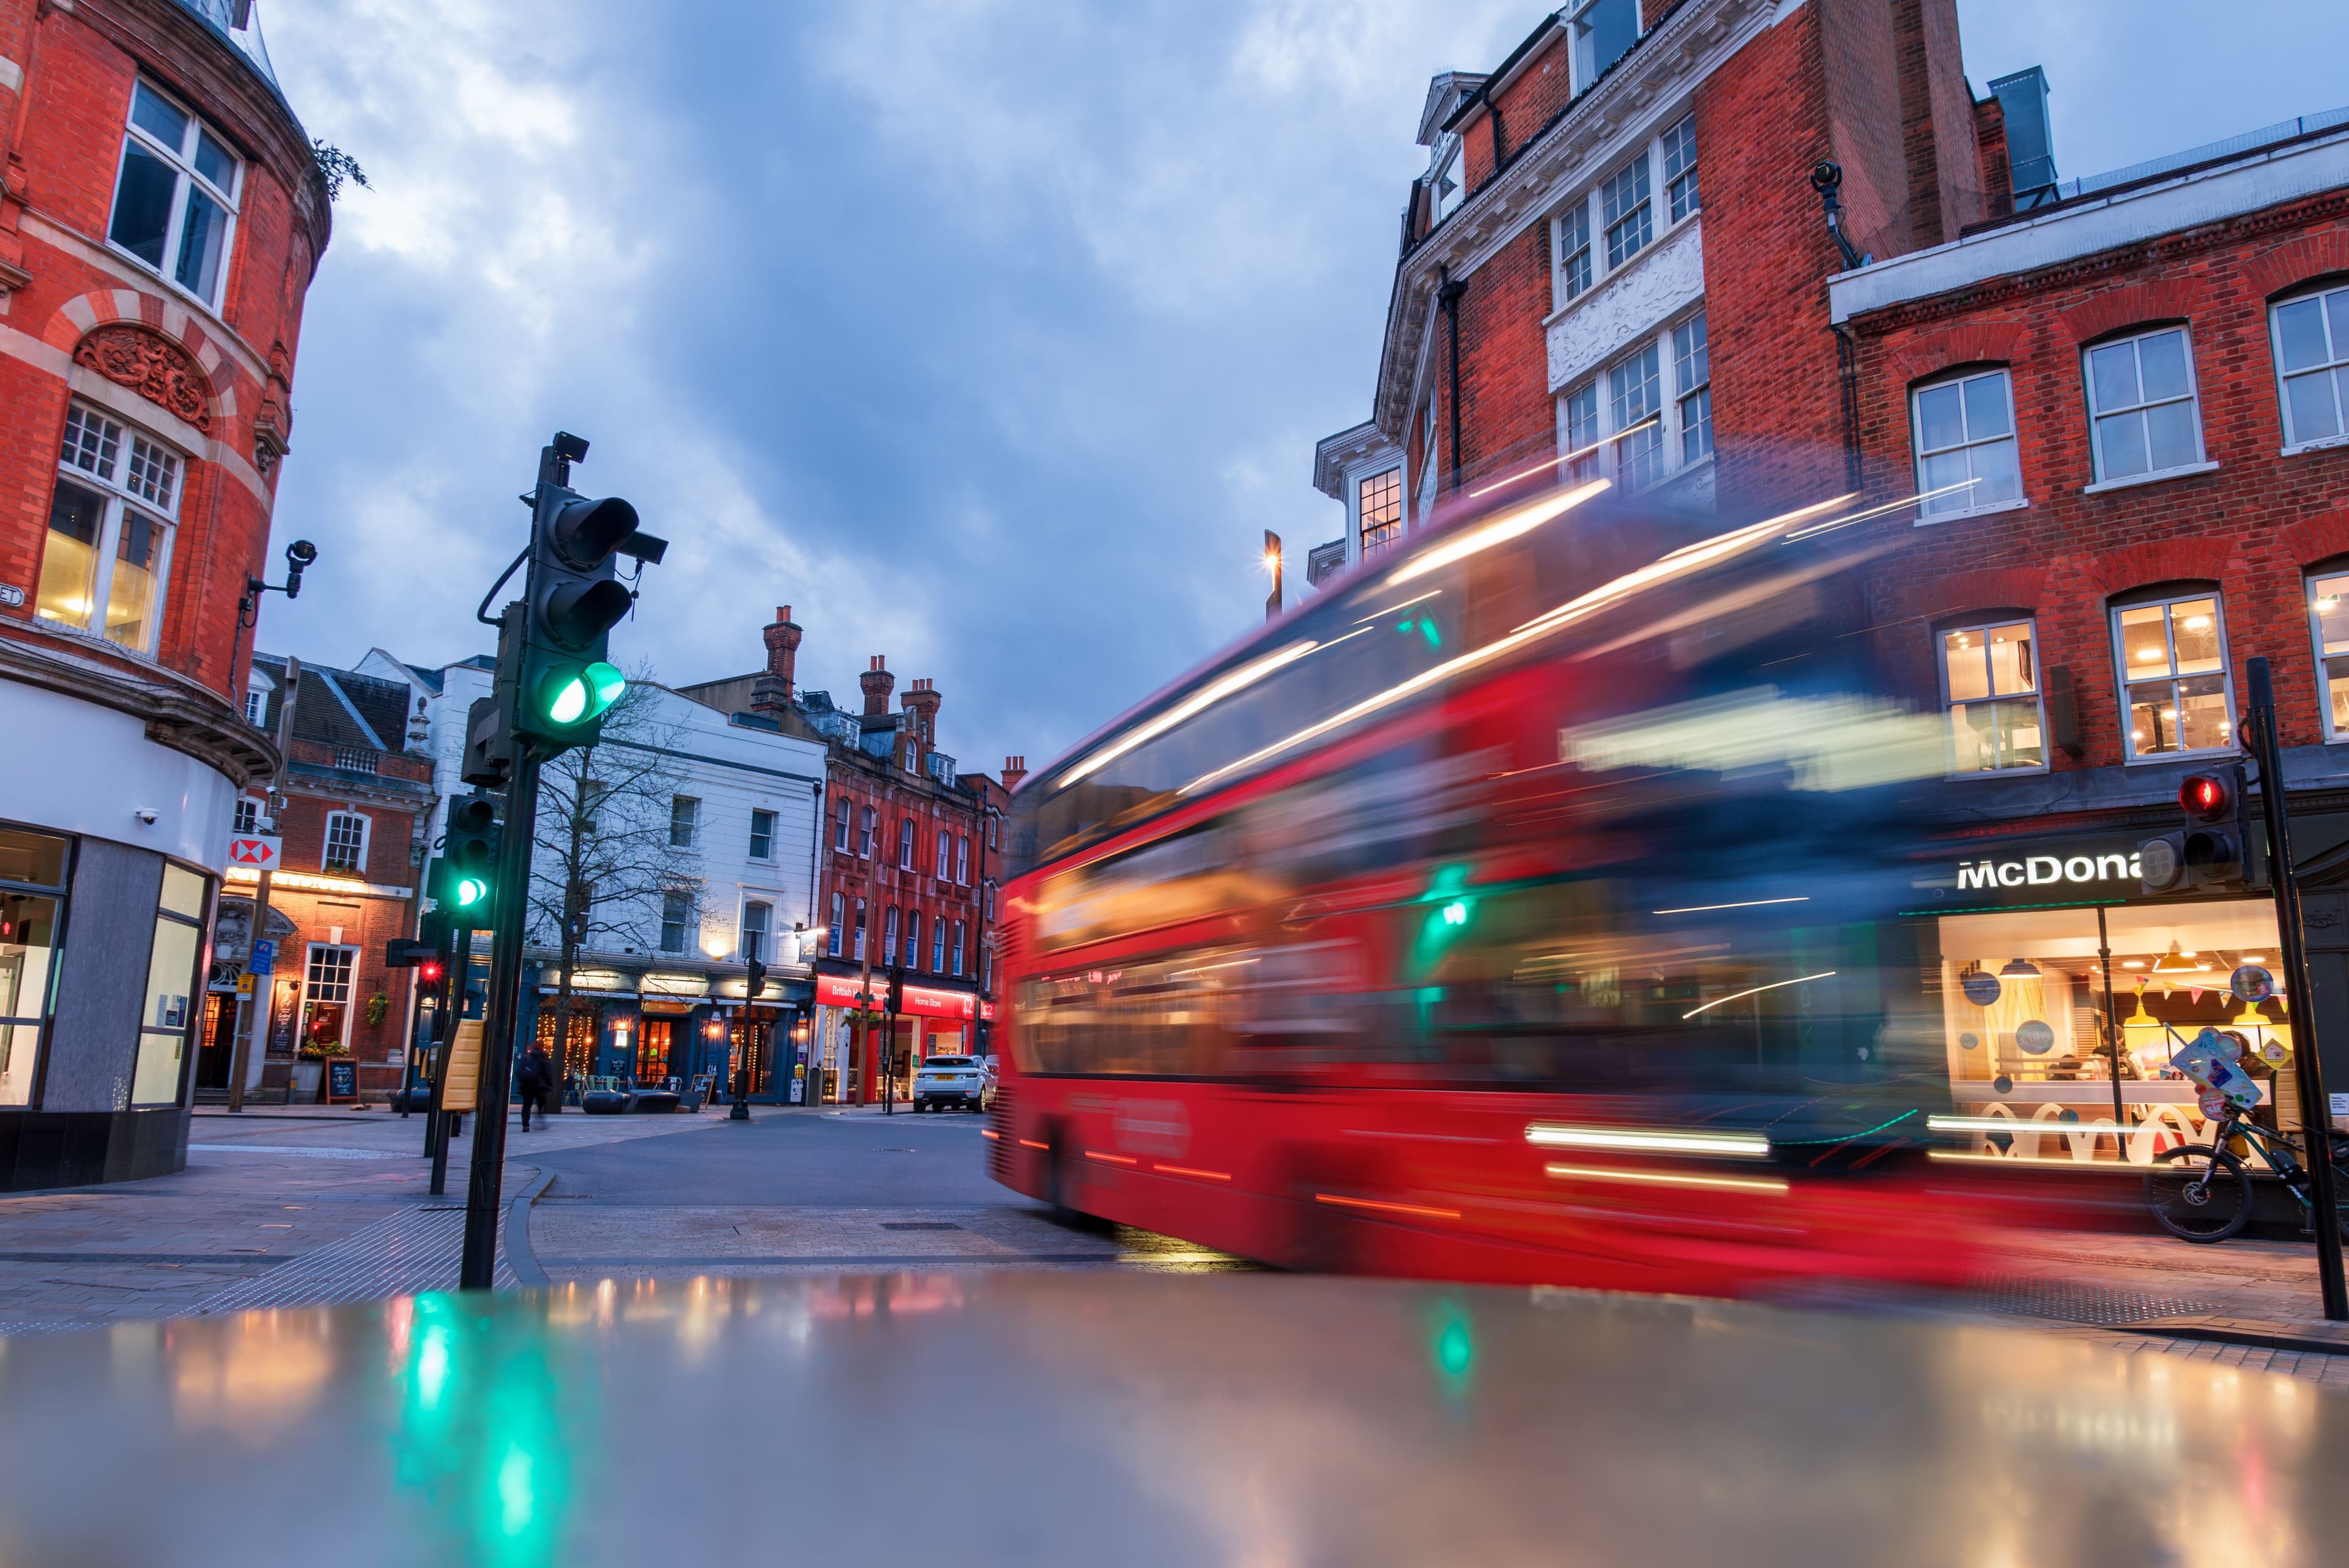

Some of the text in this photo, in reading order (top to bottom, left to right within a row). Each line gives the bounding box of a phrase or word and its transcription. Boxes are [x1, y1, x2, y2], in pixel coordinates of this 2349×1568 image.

[1958, 852, 2143, 889] McDona
[832, 985, 852, 997] British
[915, 997, 941, 1007] Home Store
